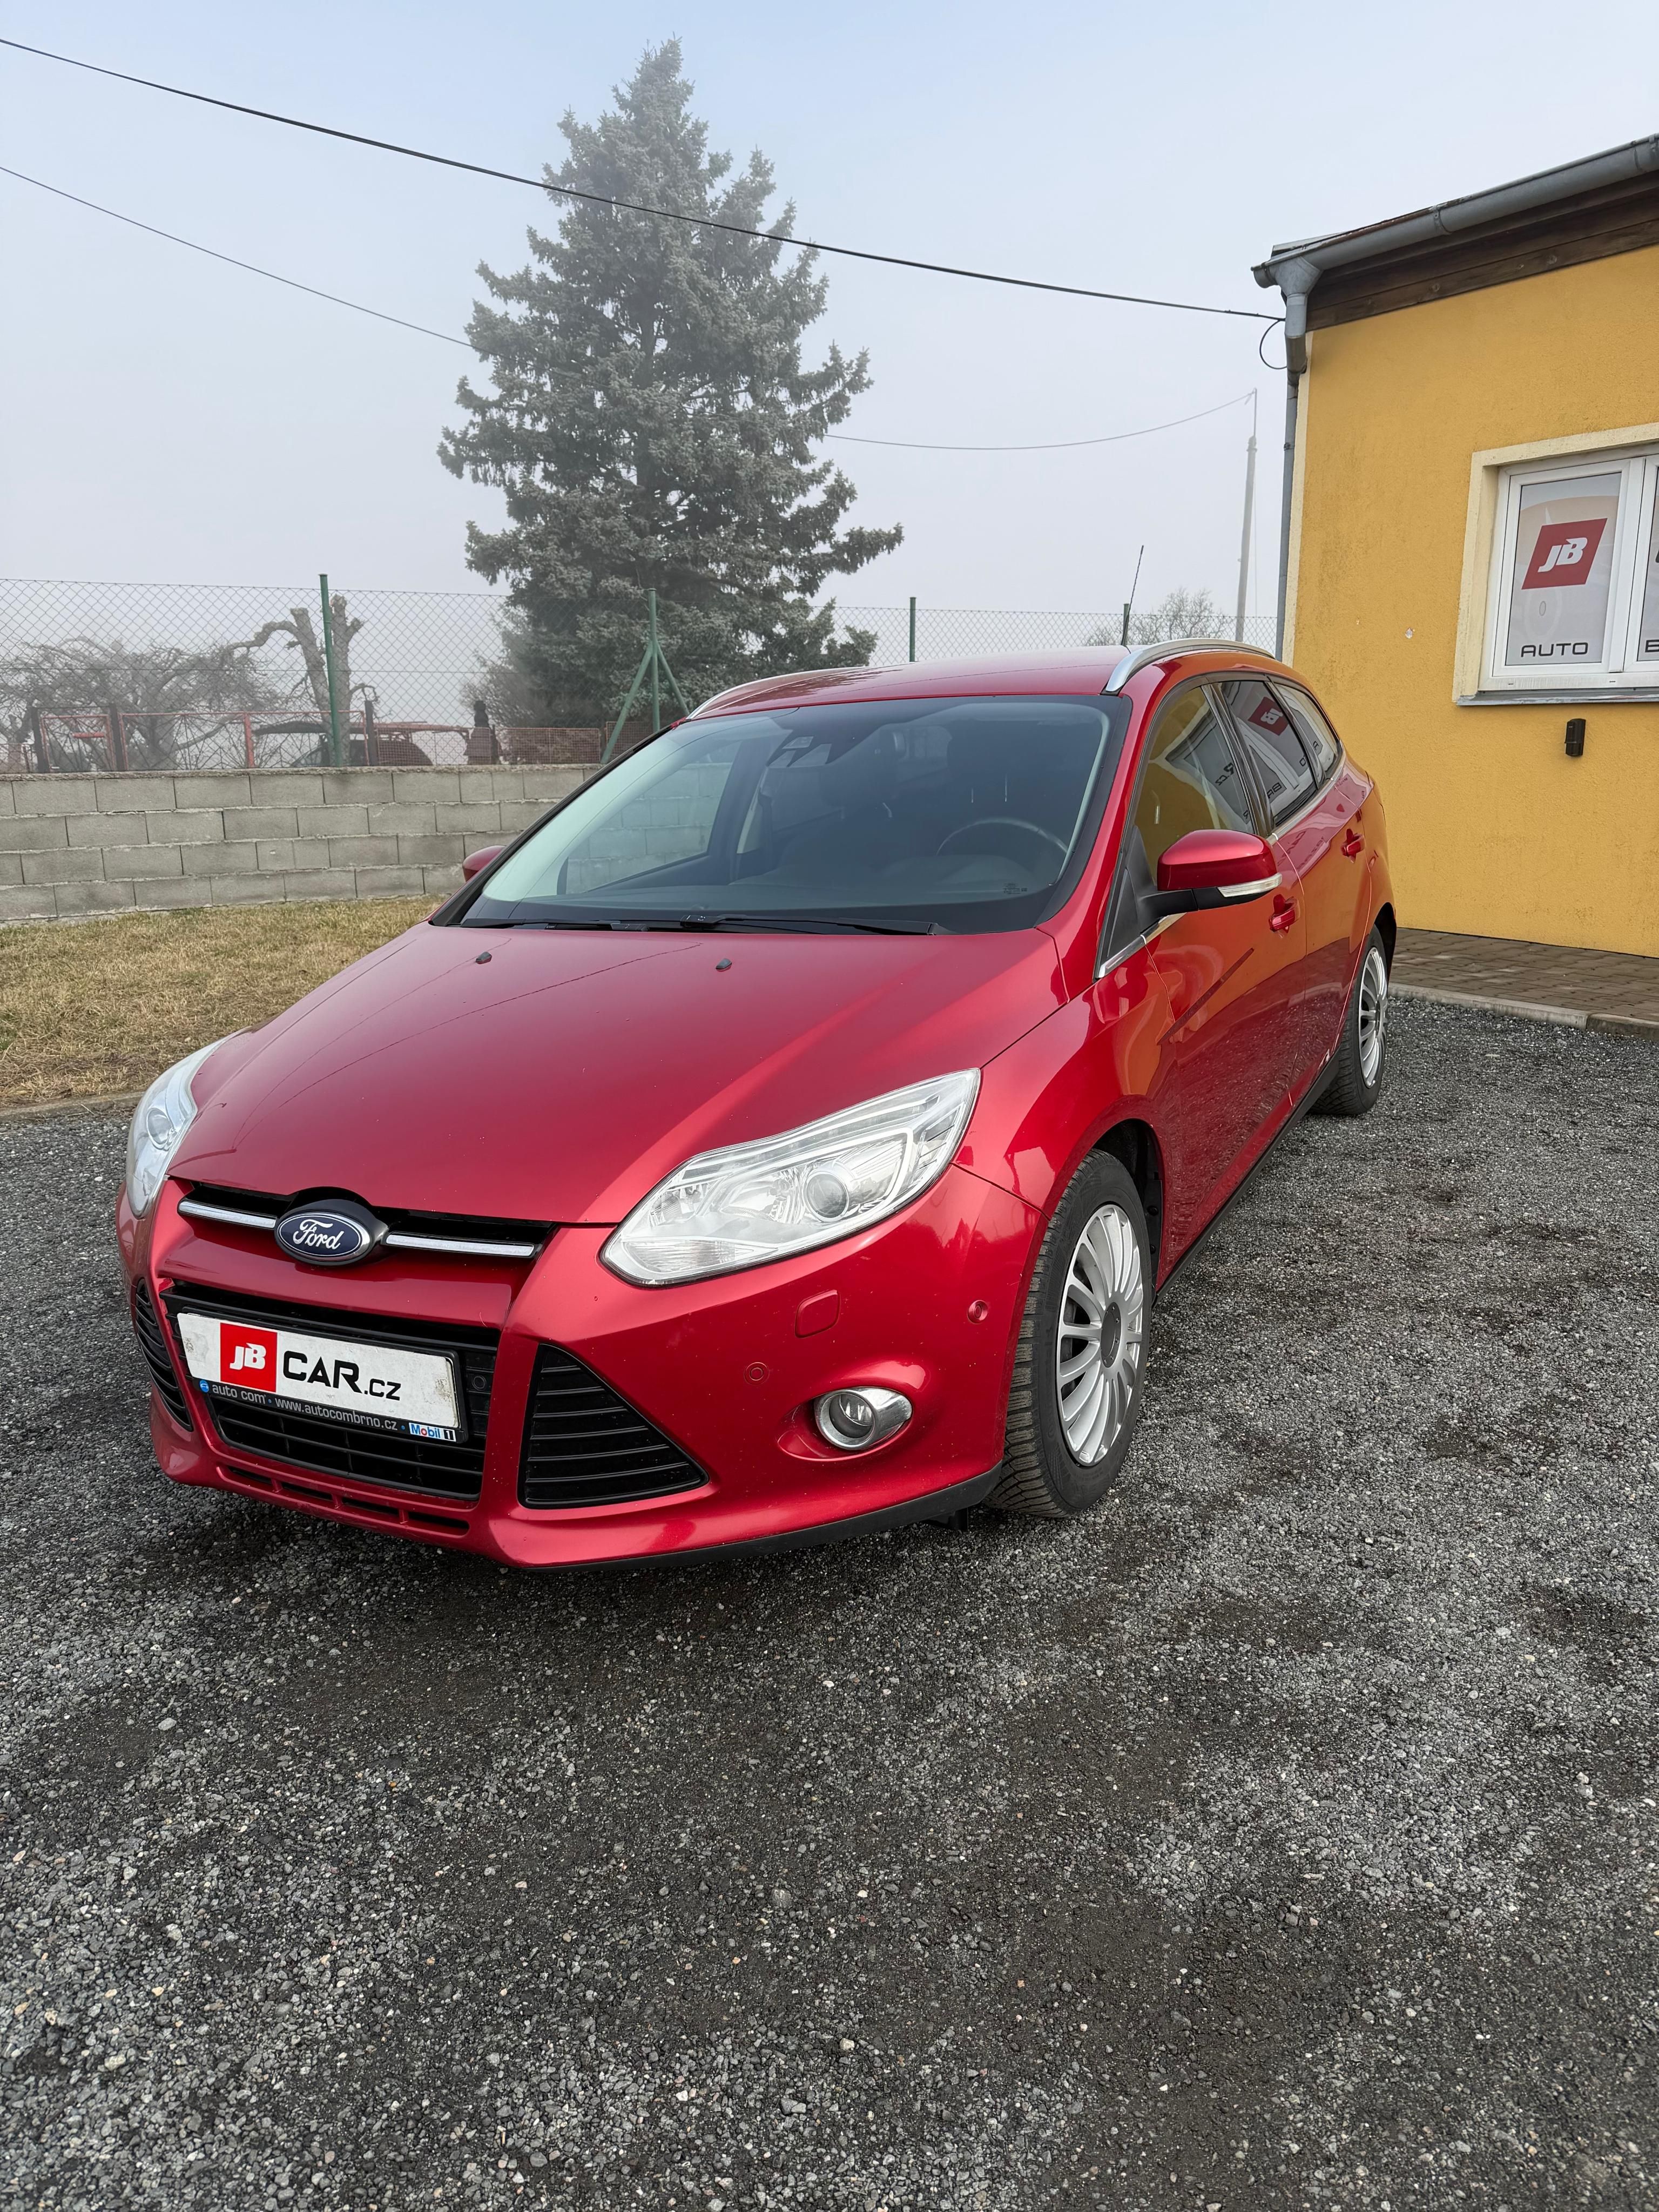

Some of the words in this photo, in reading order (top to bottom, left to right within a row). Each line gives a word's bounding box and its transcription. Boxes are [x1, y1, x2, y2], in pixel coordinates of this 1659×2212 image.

[1537, 537, 1588, 573] JB
[1521, 642, 1588, 657] AUTO
[293, 1219, 345, 1250] Ford
[230, 1343, 266, 1370] JB
[212, 1384, 238, 1398] auto
[241, 1390, 266, 1404] com
[275, 1398, 398, 1431] www.autocombrno.cz
[411, 1424, 441, 1439] Mobil
